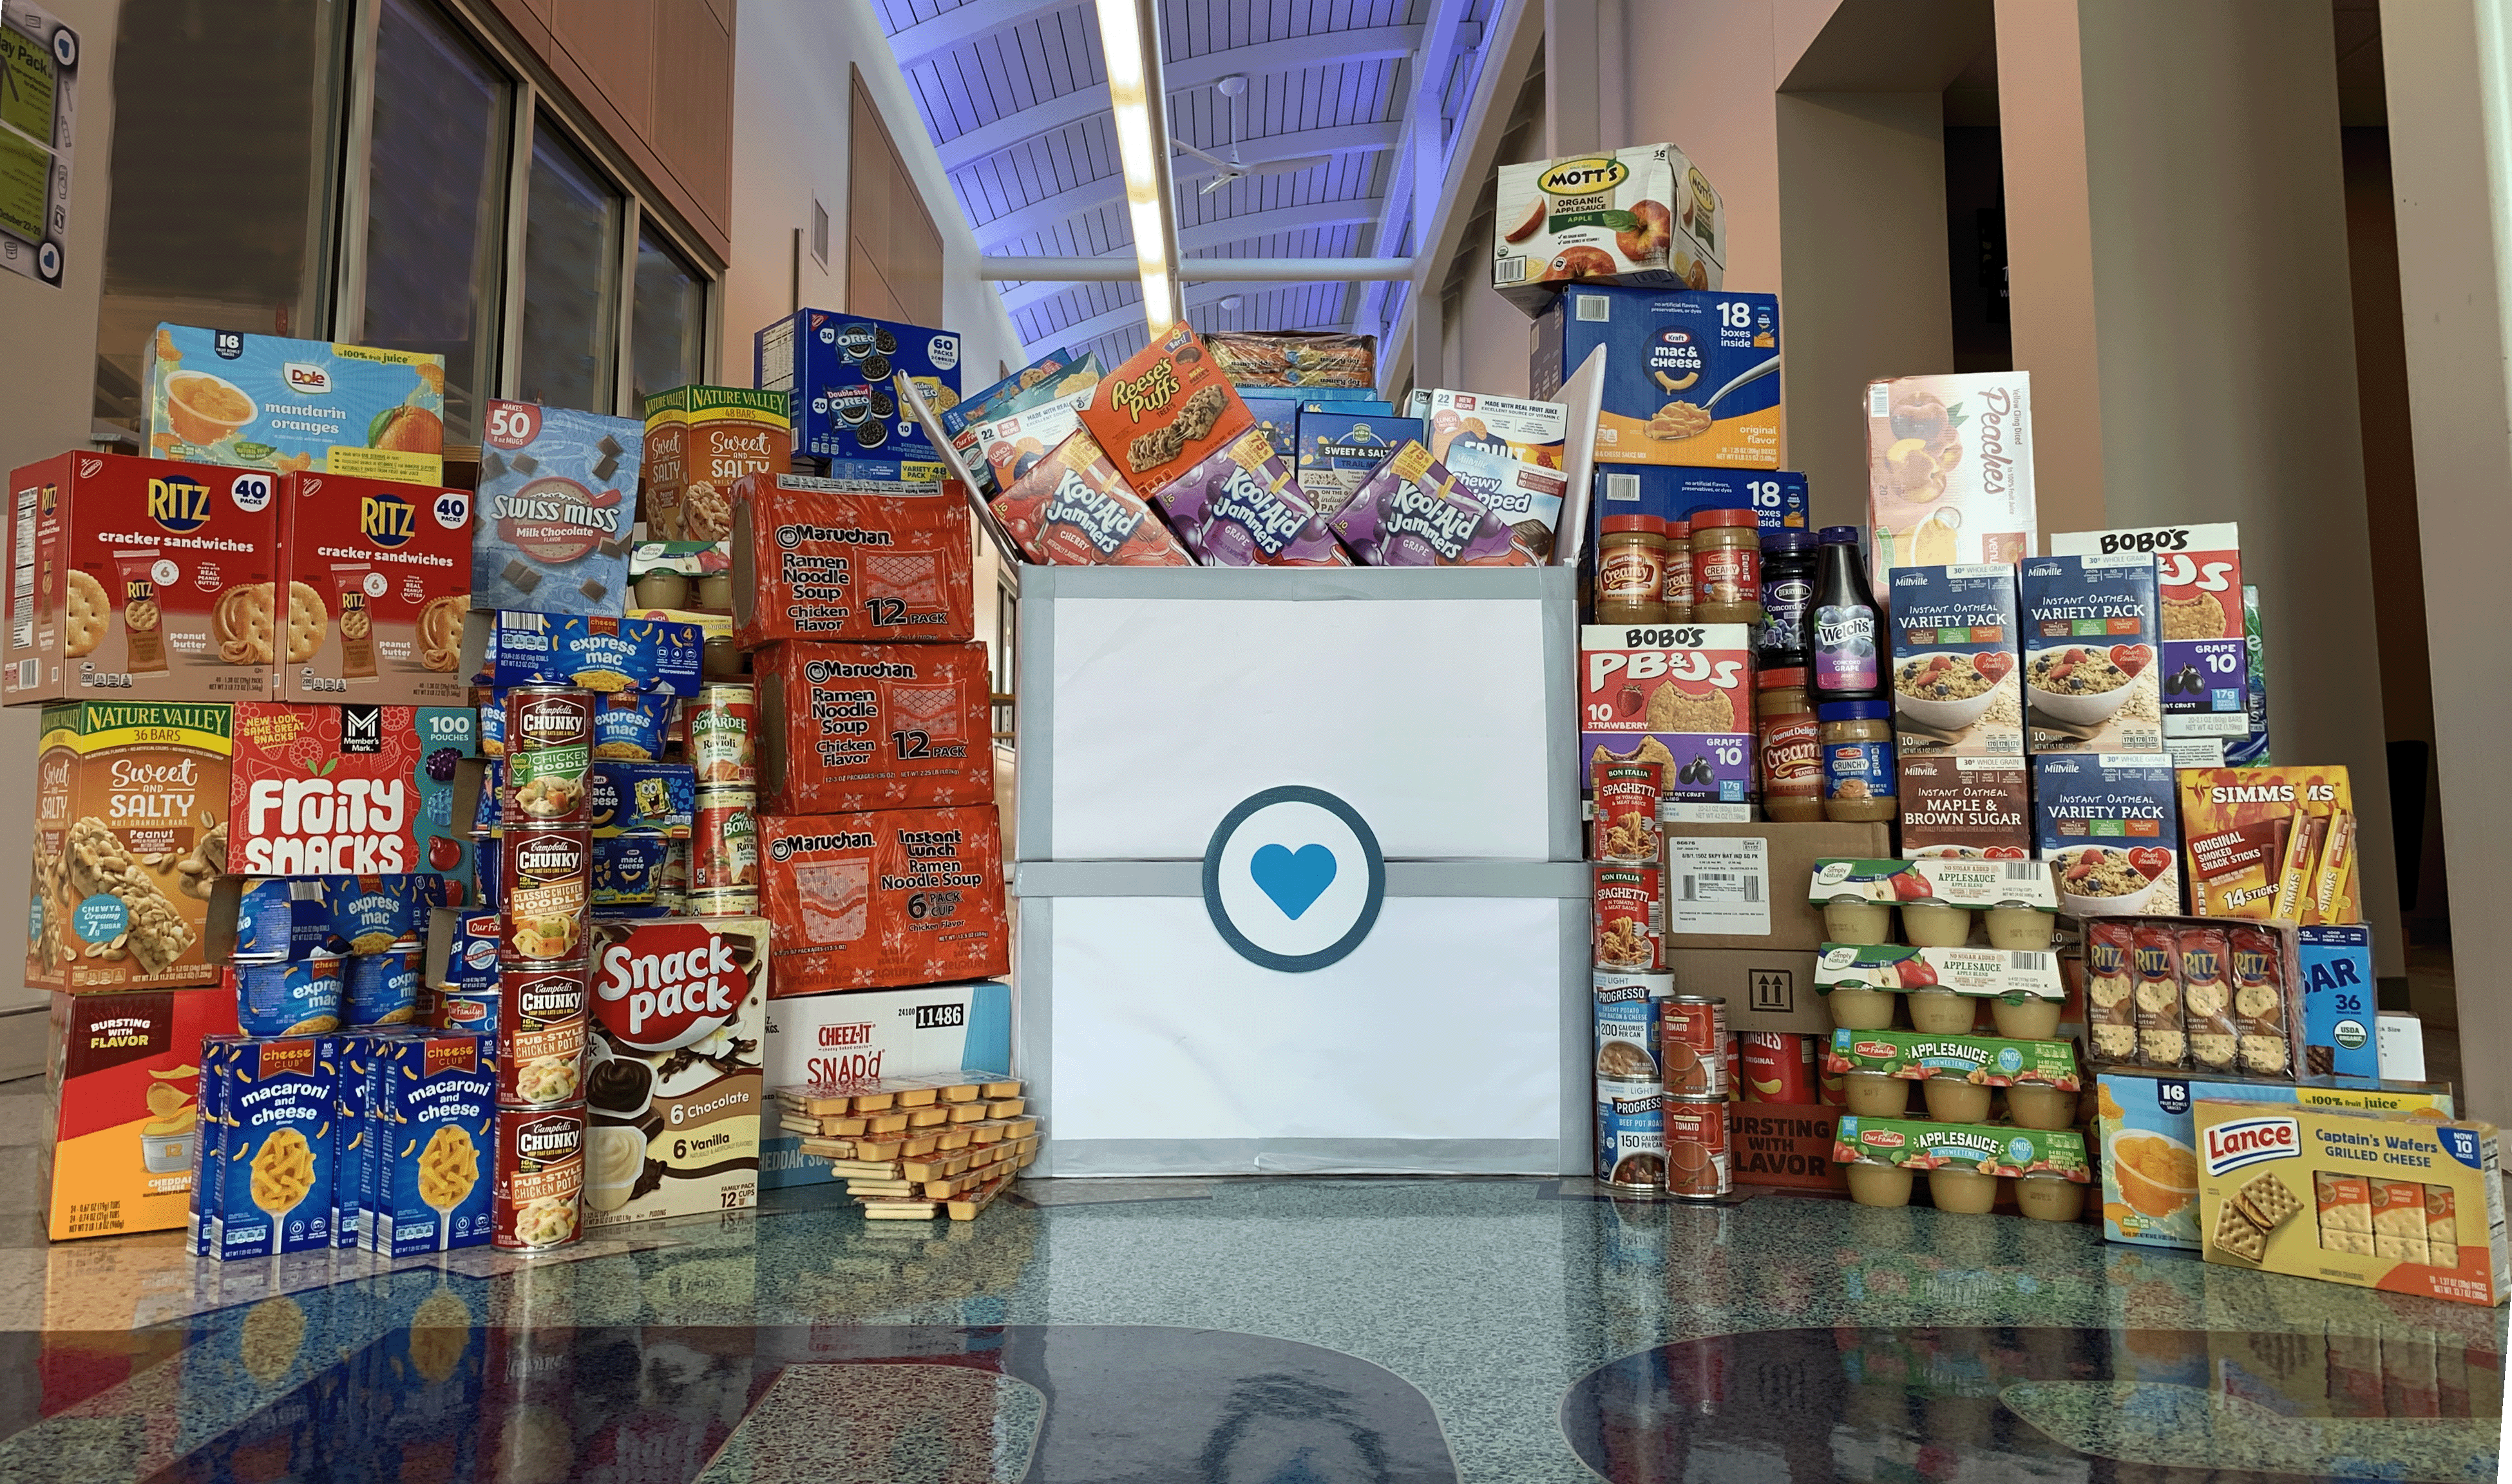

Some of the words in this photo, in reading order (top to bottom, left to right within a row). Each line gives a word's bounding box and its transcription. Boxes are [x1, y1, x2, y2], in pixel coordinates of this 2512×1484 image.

[19, 45, 47, 76] Pack
[1548, 167, 1618, 187] MOTT'S
[1558, 196, 1604, 206] ORGANIC
[1556, 204, 1606, 214] APPLESAUCE
[1717, 302, 1751, 328] 18
[837, 334, 875, 346] OREO
[1721, 328, 1751, 338] boxes
[220, 334, 239, 348] 16
[934, 338, 953, 350] 60
[1721, 338, 1751, 348] inside
[1655, 347, 1685, 357] mac
[1687, 347, 1697, 357] &
[292, 368, 325, 385] Dole
[1111, 357, 1173, 412] Reese's
[1130, 375, 1180, 423] Puffs
[265, 403, 346, 420] mandarin
[502, 403, 523, 412] MAKES
[1157, 403, 1175, 418] TREATS
[272, 418, 339, 434] oranges
[491, 410, 530, 438] 50
[1740, 426, 1776, 436] original
[1747, 435, 1776, 444] flavor
[1978, 387, 2013, 495] Peaches
[1325, 447, 1356, 455] SWEET
[235, 480, 266, 499] 40
[148, 479, 210, 521] RITZ
[1054, 469, 1144, 536] Kool-Aid
[491, 494, 560, 520] SWISS
[565, 503, 620, 532] MISS
[517, 527, 539, 537] Milk
[541, 527, 593, 537] Chocolate
[1046, 501, 1119, 553] Jammers
[99, 532, 160, 546] cracker
[164, 537, 254, 553] sandwiches
[1060, 531, 1090, 550] CHERRY
[1896, 577, 1928, 587] Millville
[1910, 605, 1948, 614] INSTANT
[1954, 604, 1997, 613] OATMEAL
[1899, 615, 1962, 628] VARIETY
[1968, 613, 2006, 625] PACK
[170, 632, 206, 642] peanut
[1626, 627, 1706, 648] BOBO'S
[1822, 619, 1869, 643] Welch's
[173, 640, 206, 649] butter
[570, 637, 637, 656] express
[586, 651, 622, 665] mac
[824, 661, 916, 679] Maruchan
[813, 689, 875, 703] Ramen
[535, 705, 572, 716] Campbell's
[812, 703, 877, 718] Noodle
[1588, 704, 1612, 721] 10
[85, 707, 160, 734] NATURE
[164, 709, 227, 736] VALLEY
[247, 718, 271, 727] NEW
[273, 713, 300, 727] LOOK,
[430, 716, 470, 733] 100
[523, 714, 583, 732] CHUNKY
[822, 719, 868, 736] Soup
[135, 729, 147, 741] 36
[150, 729, 181, 741] BARS
[243, 726, 271, 737] SAME
[274, 722, 304, 734] GREAT
[254, 732, 297, 745] SNACKS!
[344, 737, 379, 746] Member's
[893, 730, 929, 759] 12
[933, 746, 967, 758] PACK
[816, 739, 875, 754] Chicken
[533, 750, 588, 765] CHICKEN
[824, 754, 869, 766] Flavor
[1715, 748, 1742, 765] 10
[533, 759, 589, 772] NOODLE
[1834, 760, 1867, 770] CRUNCHY
[111, 758, 198, 788] Sweet
[1625, 769, 1648, 777] ITALIA
[143, 785, 163, 793] AND
[1603, 783, 1655, 797] SPAGHETTI
[2211, 785, 2296, 803] SIMMS
[109, 794, 195, 818] SALTY
[1927, 800, 1984, 812] MAPLE
[1986, 799, 1997, 811] &
[1905, 813, 1966, 825] BROWN
[1969, 813, 2021, 825] SUGAR
[129, 829, 174, 840] Peanut
[2193, 832, 2245, 854] ORIGINAL
[2198, 847, 2232, 863] SMOKED
[2202, 858, 2229, 871] SNACK
[2231, 849, 2261, 862] STICKS
[1938, 873, 1995, 882] APPLESAUCE
[2223, 888, 2246, 909] 14
[2245, 884, 2280, 901] STICKS
[2091, 947, 2124, 967] RITZ
[598, 936, 736, 1001] Snack
[630, 976, 732, 1034] pack
[899, 1007, 915, 1016] 24100
[918, 1005, 962, 1027] 11486
[90, 1018, 151, 1032] BURSTING
[108, 1028, 133, 1036] WITH
[1601, 1024, 1617, 1036] 200
[1666, 1022, 1688, 1032] TOMATO
[91, 1035, 149, 1049] FLAVOR
[819, 1024, 871, 1047] CHEEZ-IT
[1911, 1043, 1989, 1064] APPLESAUCE
[241, 1082, 330, 1107] macaroni
[2162, 1085, 2185, 1101] 16
[275, 1096, 296, 1106] and
[671, 1104, 684, 1125] 6
[687, 1090, 749, 1119] Chocolate
[2312, 1096, 2343, 1106] 100%
[2364, 1098, 2398, 1109] juice
[251, 1106, 317, 1126] cheese
[2209, 1126, 2292, 1159] Lance
[2316, 1128, 2379, 1146] Captain's
[2386, 1136, 2438, 1153] Wafers
[2453, 1132, 2473, 1141] NOW
[673, 1139, 687, 1159] 6
[690, 1132, 730, 1152] Vanilla
[2455, 1140, 2473, 1153] 10
[2325, 1146, 2378, 1162] GRILLED
[2383, 1153, 2431, 1168] CHEESE
[721, 1192, 736, 1208] 12
[739, 1189, 755, 1197] CUPS
